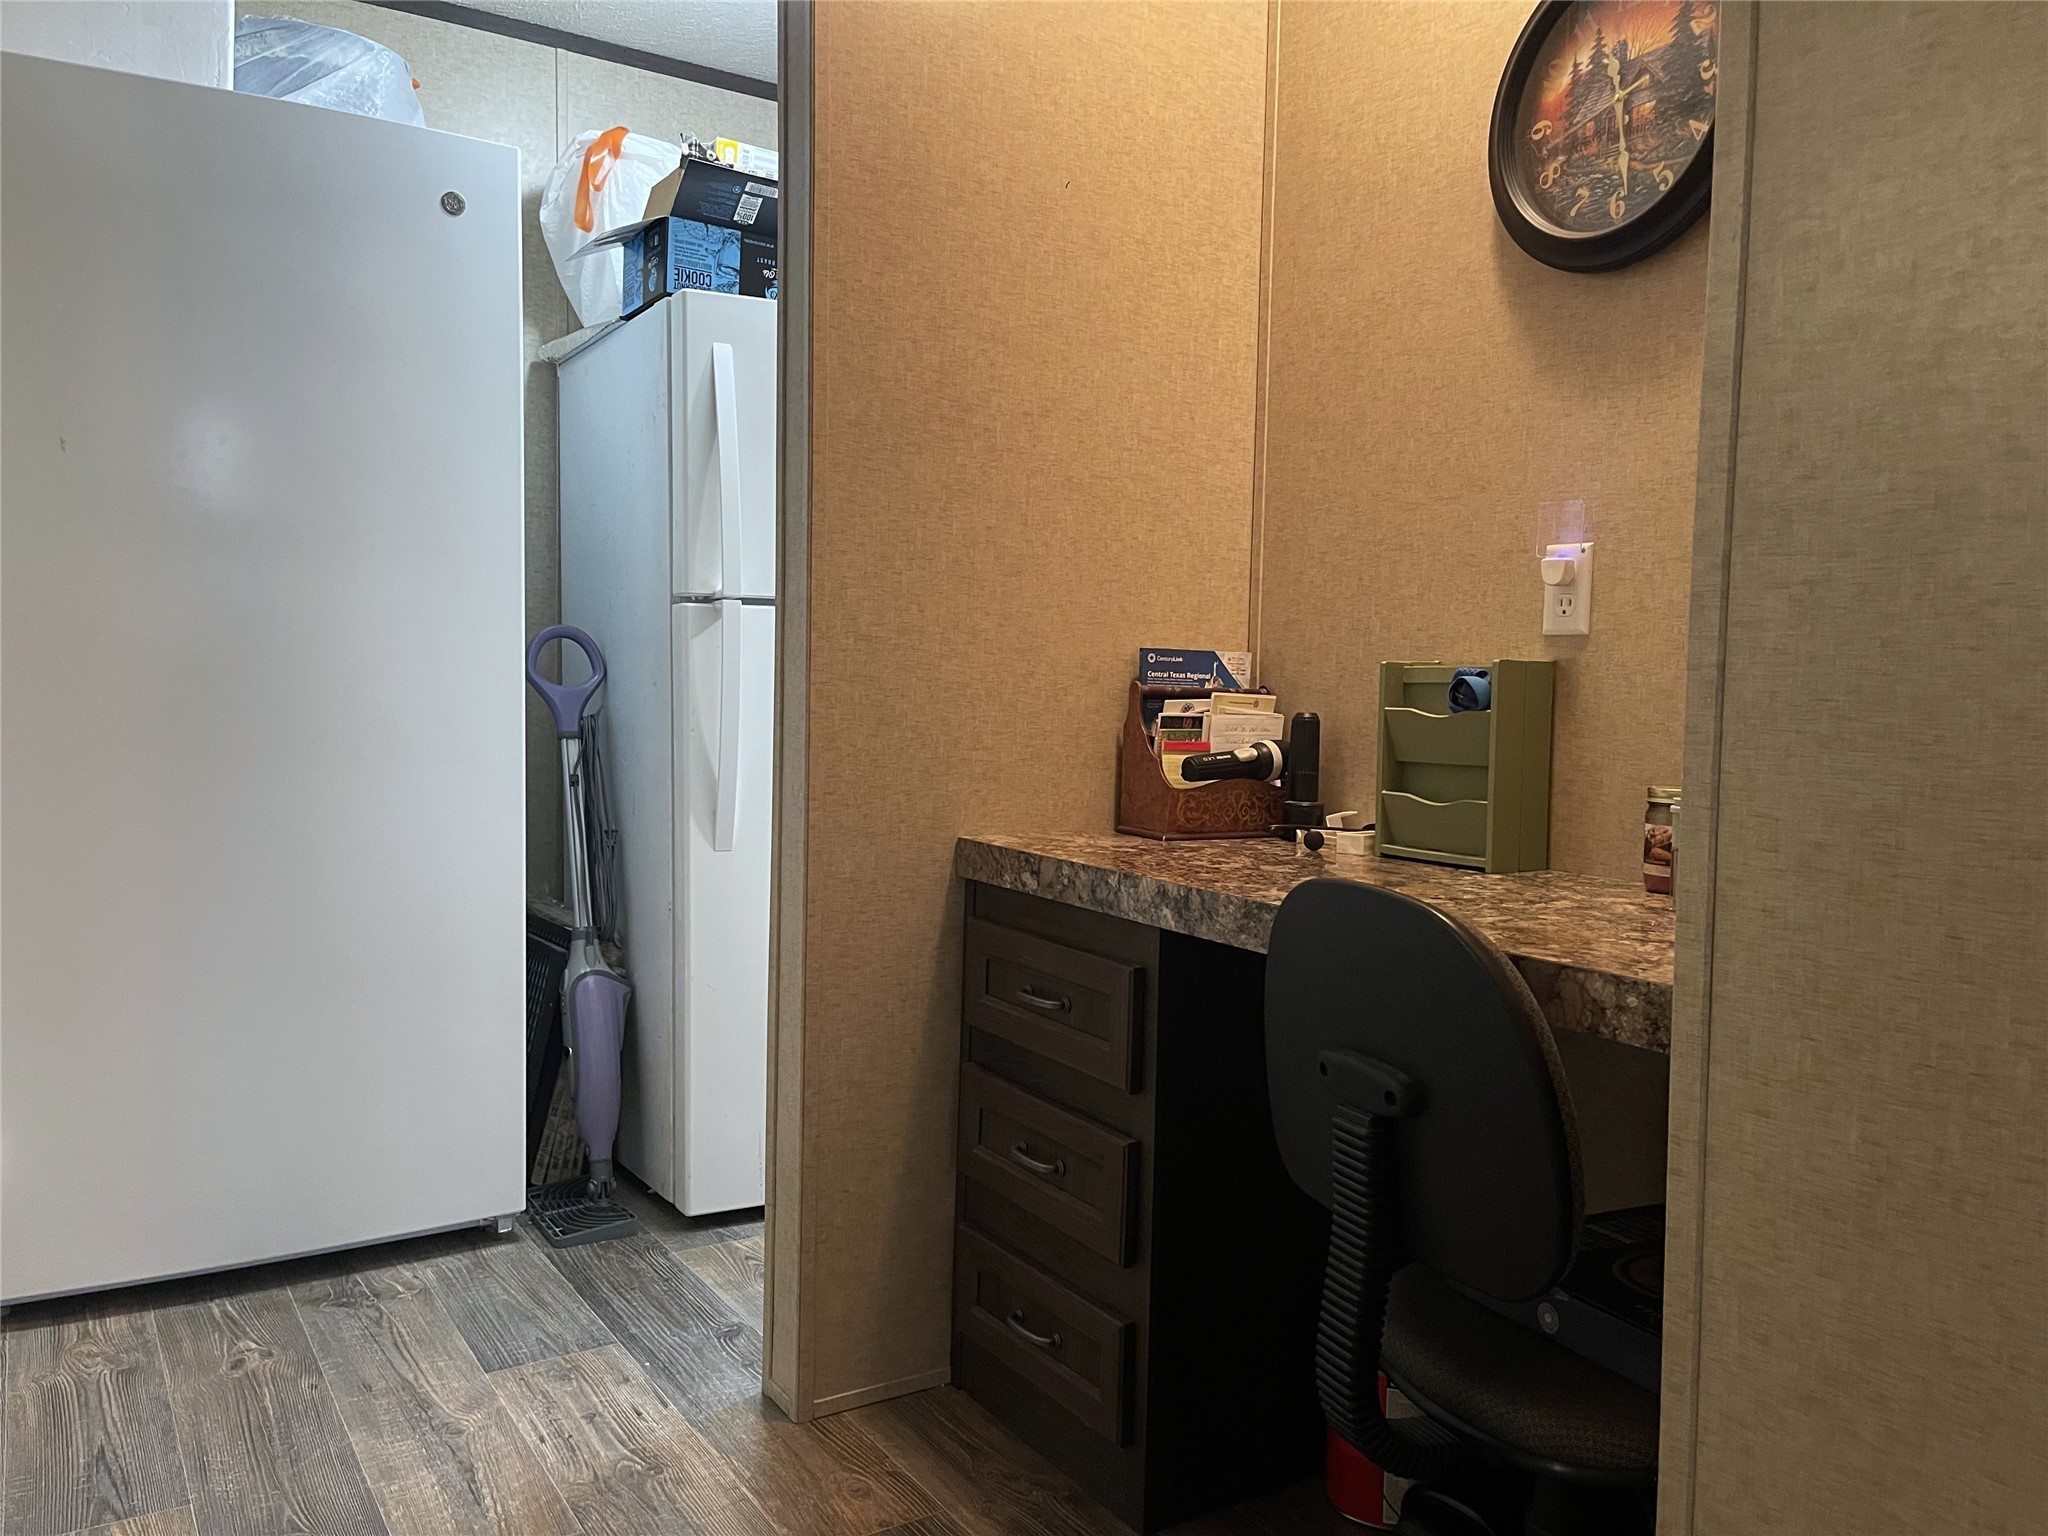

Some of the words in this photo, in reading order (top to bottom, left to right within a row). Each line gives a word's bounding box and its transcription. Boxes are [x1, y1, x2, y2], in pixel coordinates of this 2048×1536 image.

[1689, 4, 1717, 36] 2
[1700, 58, 1719, 81] 3
[1530, 119, 1553, 141] 9
[1688, 118, 1710, 141] 4
[1539, 162, 1561, 189] 8
[1652, 161, 1674, 192] 5
[1569, 189, 1590, 217] 7
[1609, 189, 1626, 219] 6
[736, 211, 754, 222] 100%
[674, 268, 712, 287] COOKIE
[1156, 655, 1183, 663] CenturyLink
[1147, 670, 1169, 678] Central
[1170, 671, 1186, 679] Texas
[1186, 672, 1211, 680] Regional
